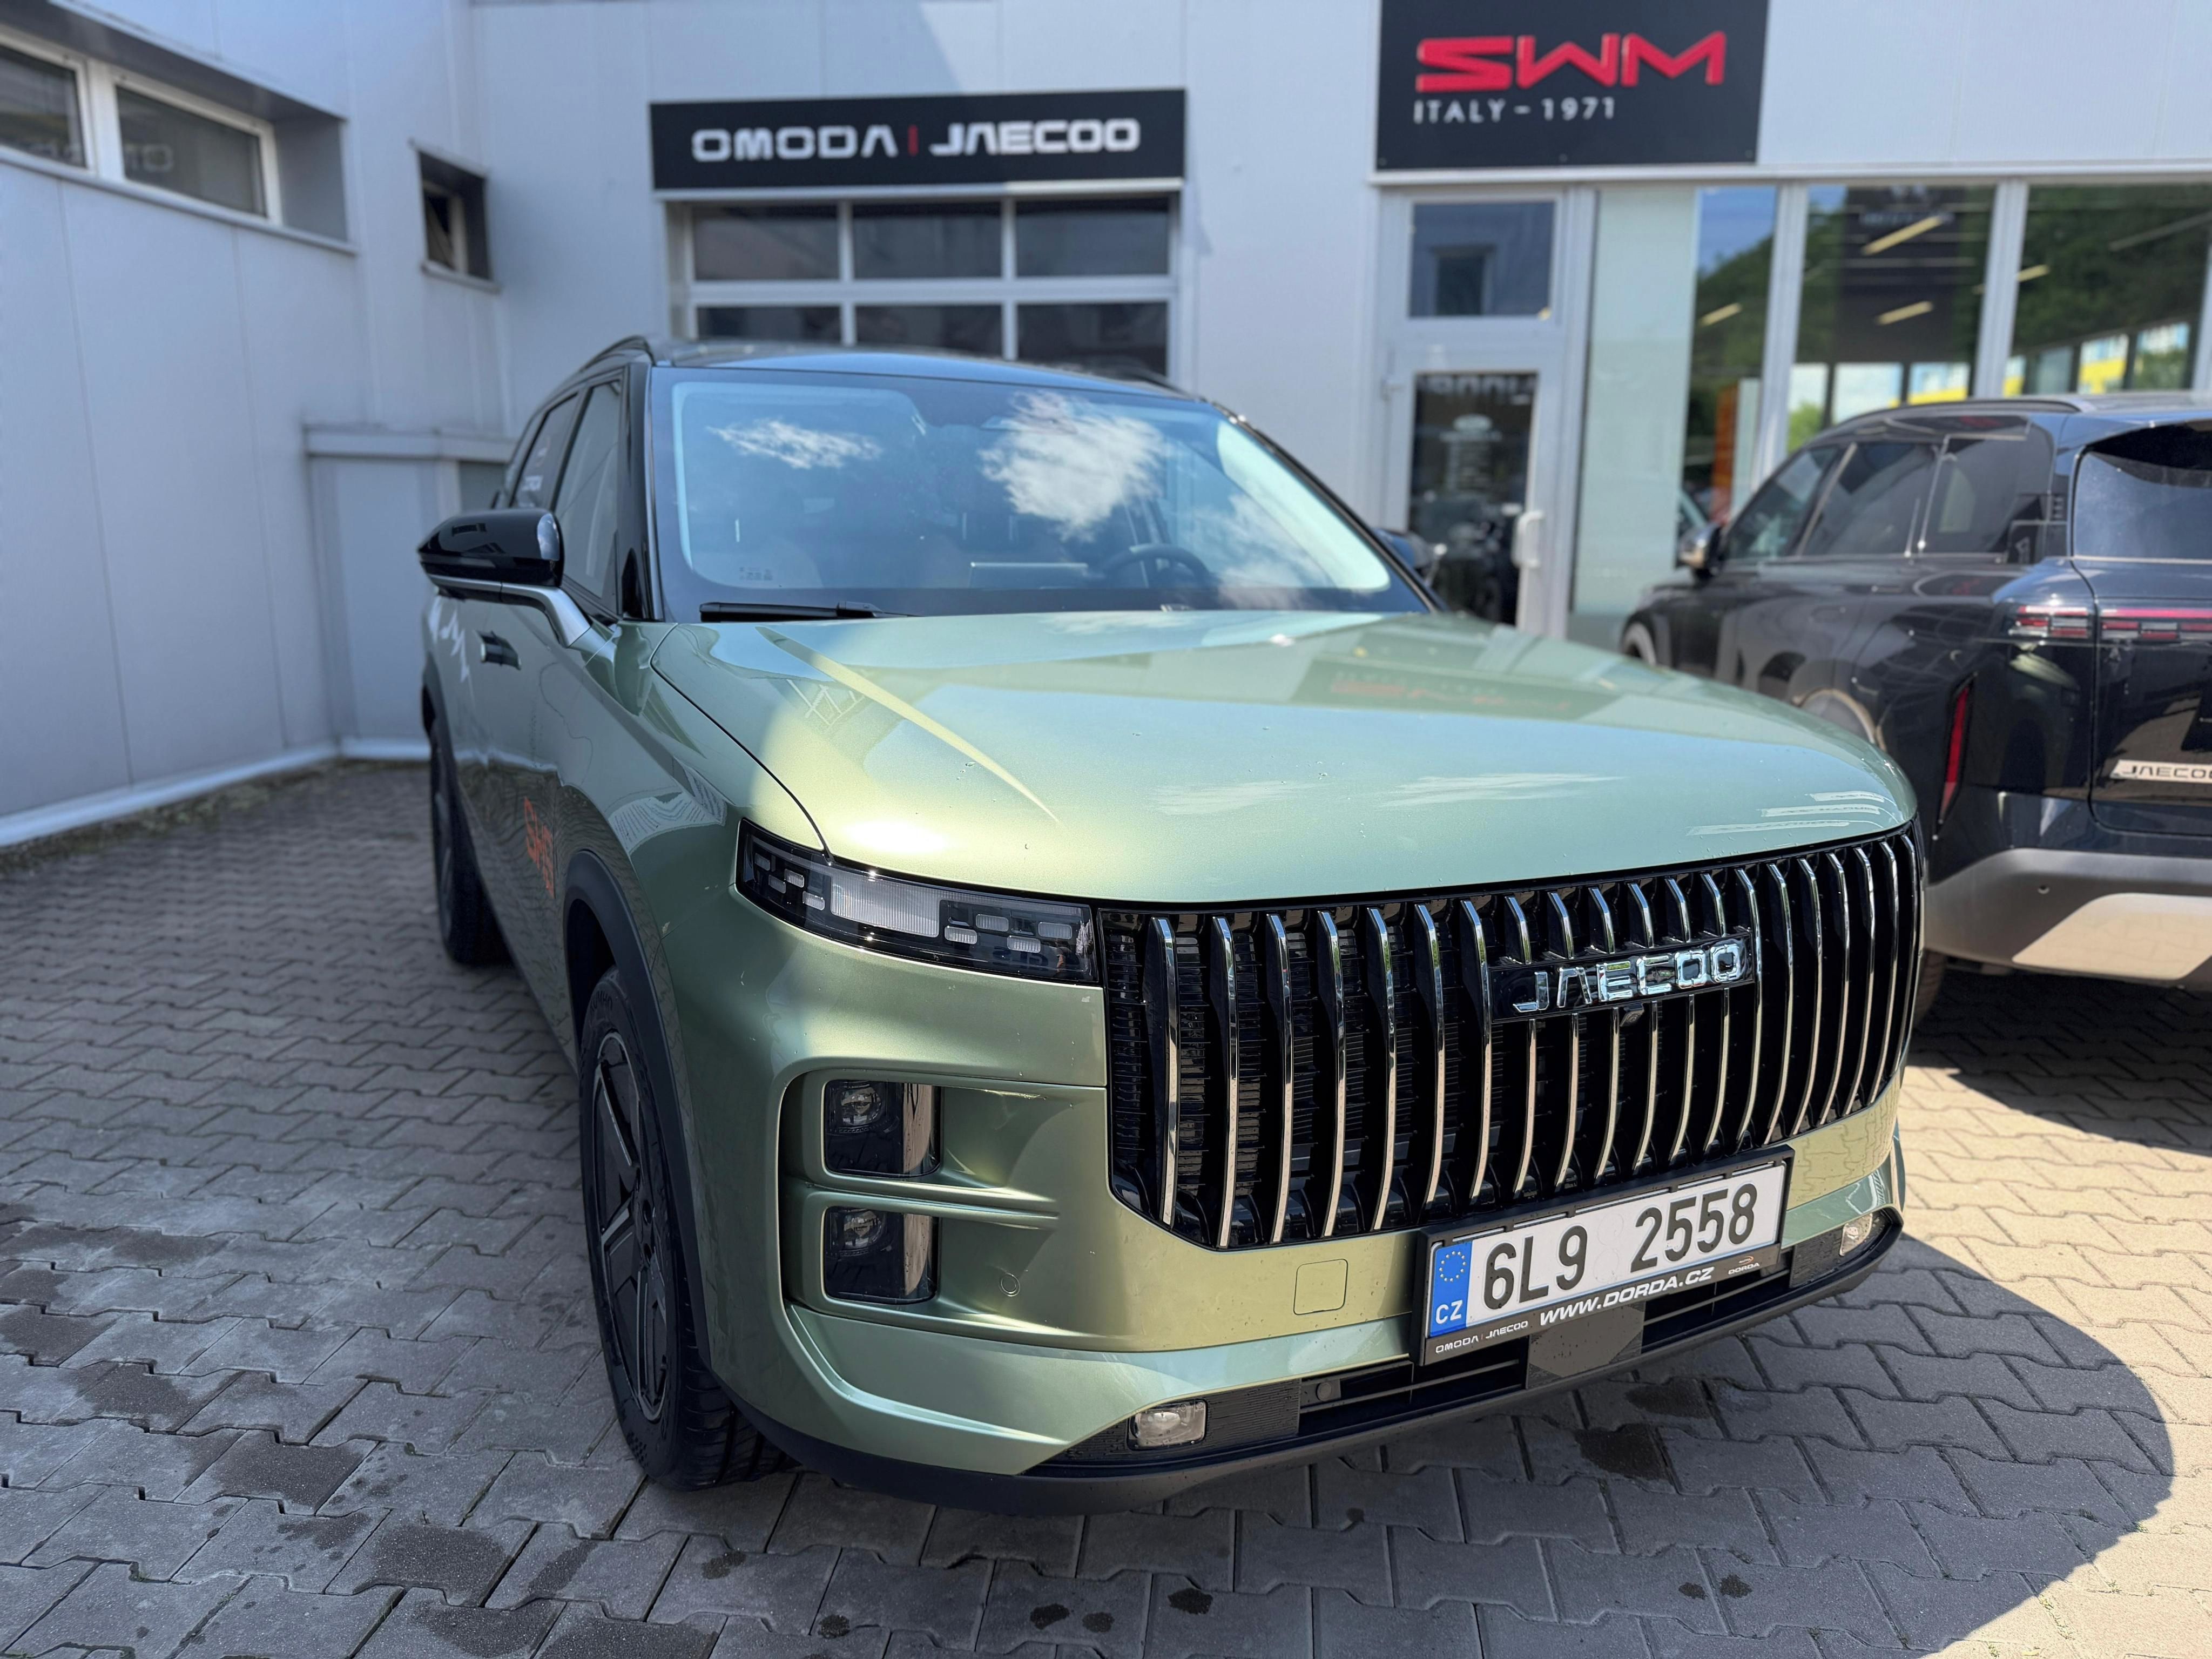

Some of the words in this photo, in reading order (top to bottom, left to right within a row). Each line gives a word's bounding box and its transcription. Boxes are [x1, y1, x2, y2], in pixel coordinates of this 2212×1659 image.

[1416, 31, 1727, 92] SWM
[1413, 99, 1506, 124] ITALY
[1542, 96, 1615, 120] 1971
[691, 125, 898, 161] OMODA
[929, 117, 1141, 156] JAECOO
[2123, 766, 2212, 779] JAECO
[1513, 942, 1741, 1013] JAECOO
[1483, 1225, 1588, 1310] 6L9
[1630, 1183, 1757, 1273] 2558
[1728, 1262, 1761, 1275] DORDA
[1435, 1300, 1463, 1324] CZ
[1540, 1266, 1715, 1326] WWW.DORDA.CZ
[1435, 1335, 1479, 1353] OMODA
[1485, 1320, 1529, 1339] JAECOO
